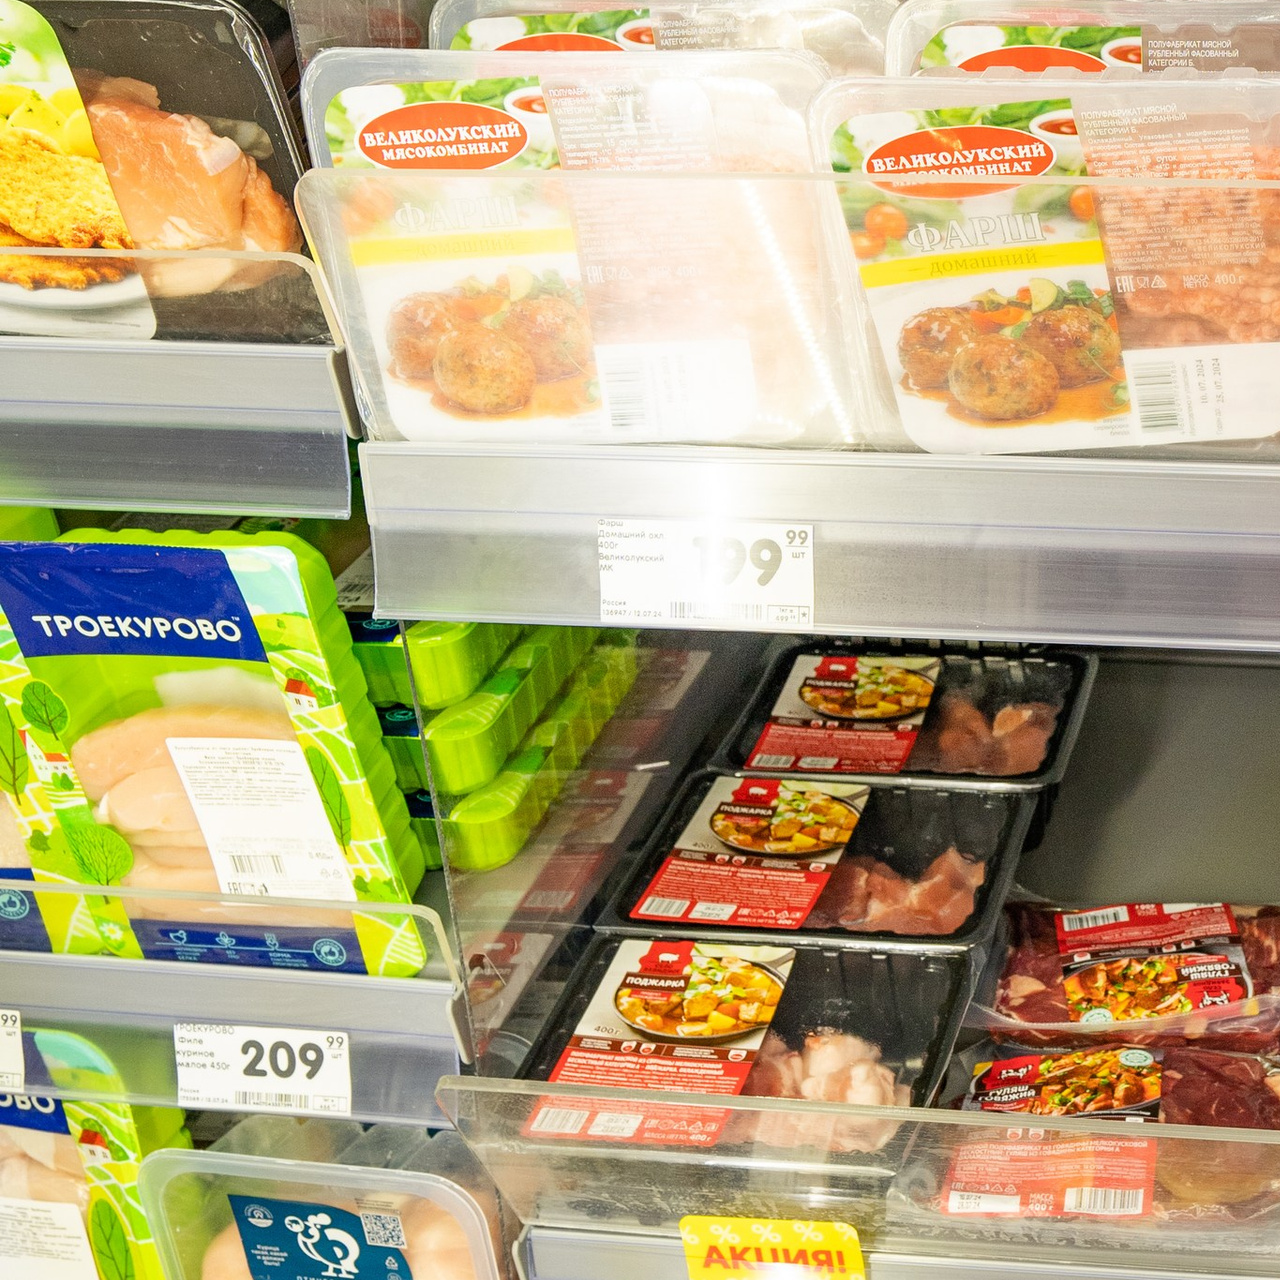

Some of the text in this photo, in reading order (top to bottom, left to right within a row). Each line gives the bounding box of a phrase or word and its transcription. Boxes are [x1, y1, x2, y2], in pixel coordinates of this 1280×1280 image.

[1148, 40, 1232, 48] ПОЛУФАБРИКАТ МЯСНОЙ
[1148, 49, 1239, 57] РУБЛЕННЫЙ ФАСОВАННЫЙ
[363, 121, 522, 149] ВЕЛИКОЛУКСКИЙ
[381, 141, 509, 162] МЯСОКОМБИНАТ
[871, 141, 1047, 173] ВЕЛИКОЛУКСКИЙ
[906, 211, 1047, 254] ФАРШ
[930, 248, 1038, 277] домашний
[786, 530, 809, 545] 99
[599, 553, 664, 562] Великолукский
[31, 614, 241, 643] ТРОЕКУРОВО
[720, 804, 774, 816] ПОДЖАРКА
[626, 976, 685, 988] ПОДЖАРКА
[178, 1037, 203, 1045] Филе
[177, 1050, 215, 1058] куриное
[241, 1036, 344, 1080] 209 99
[978, 1090, 1036, 1102] ГОВЯЖИЙ
[989, 1084, 1029, 1097] ГУЛЯШ
[703, 1245, 847, 1274] АКЦИЯ!
